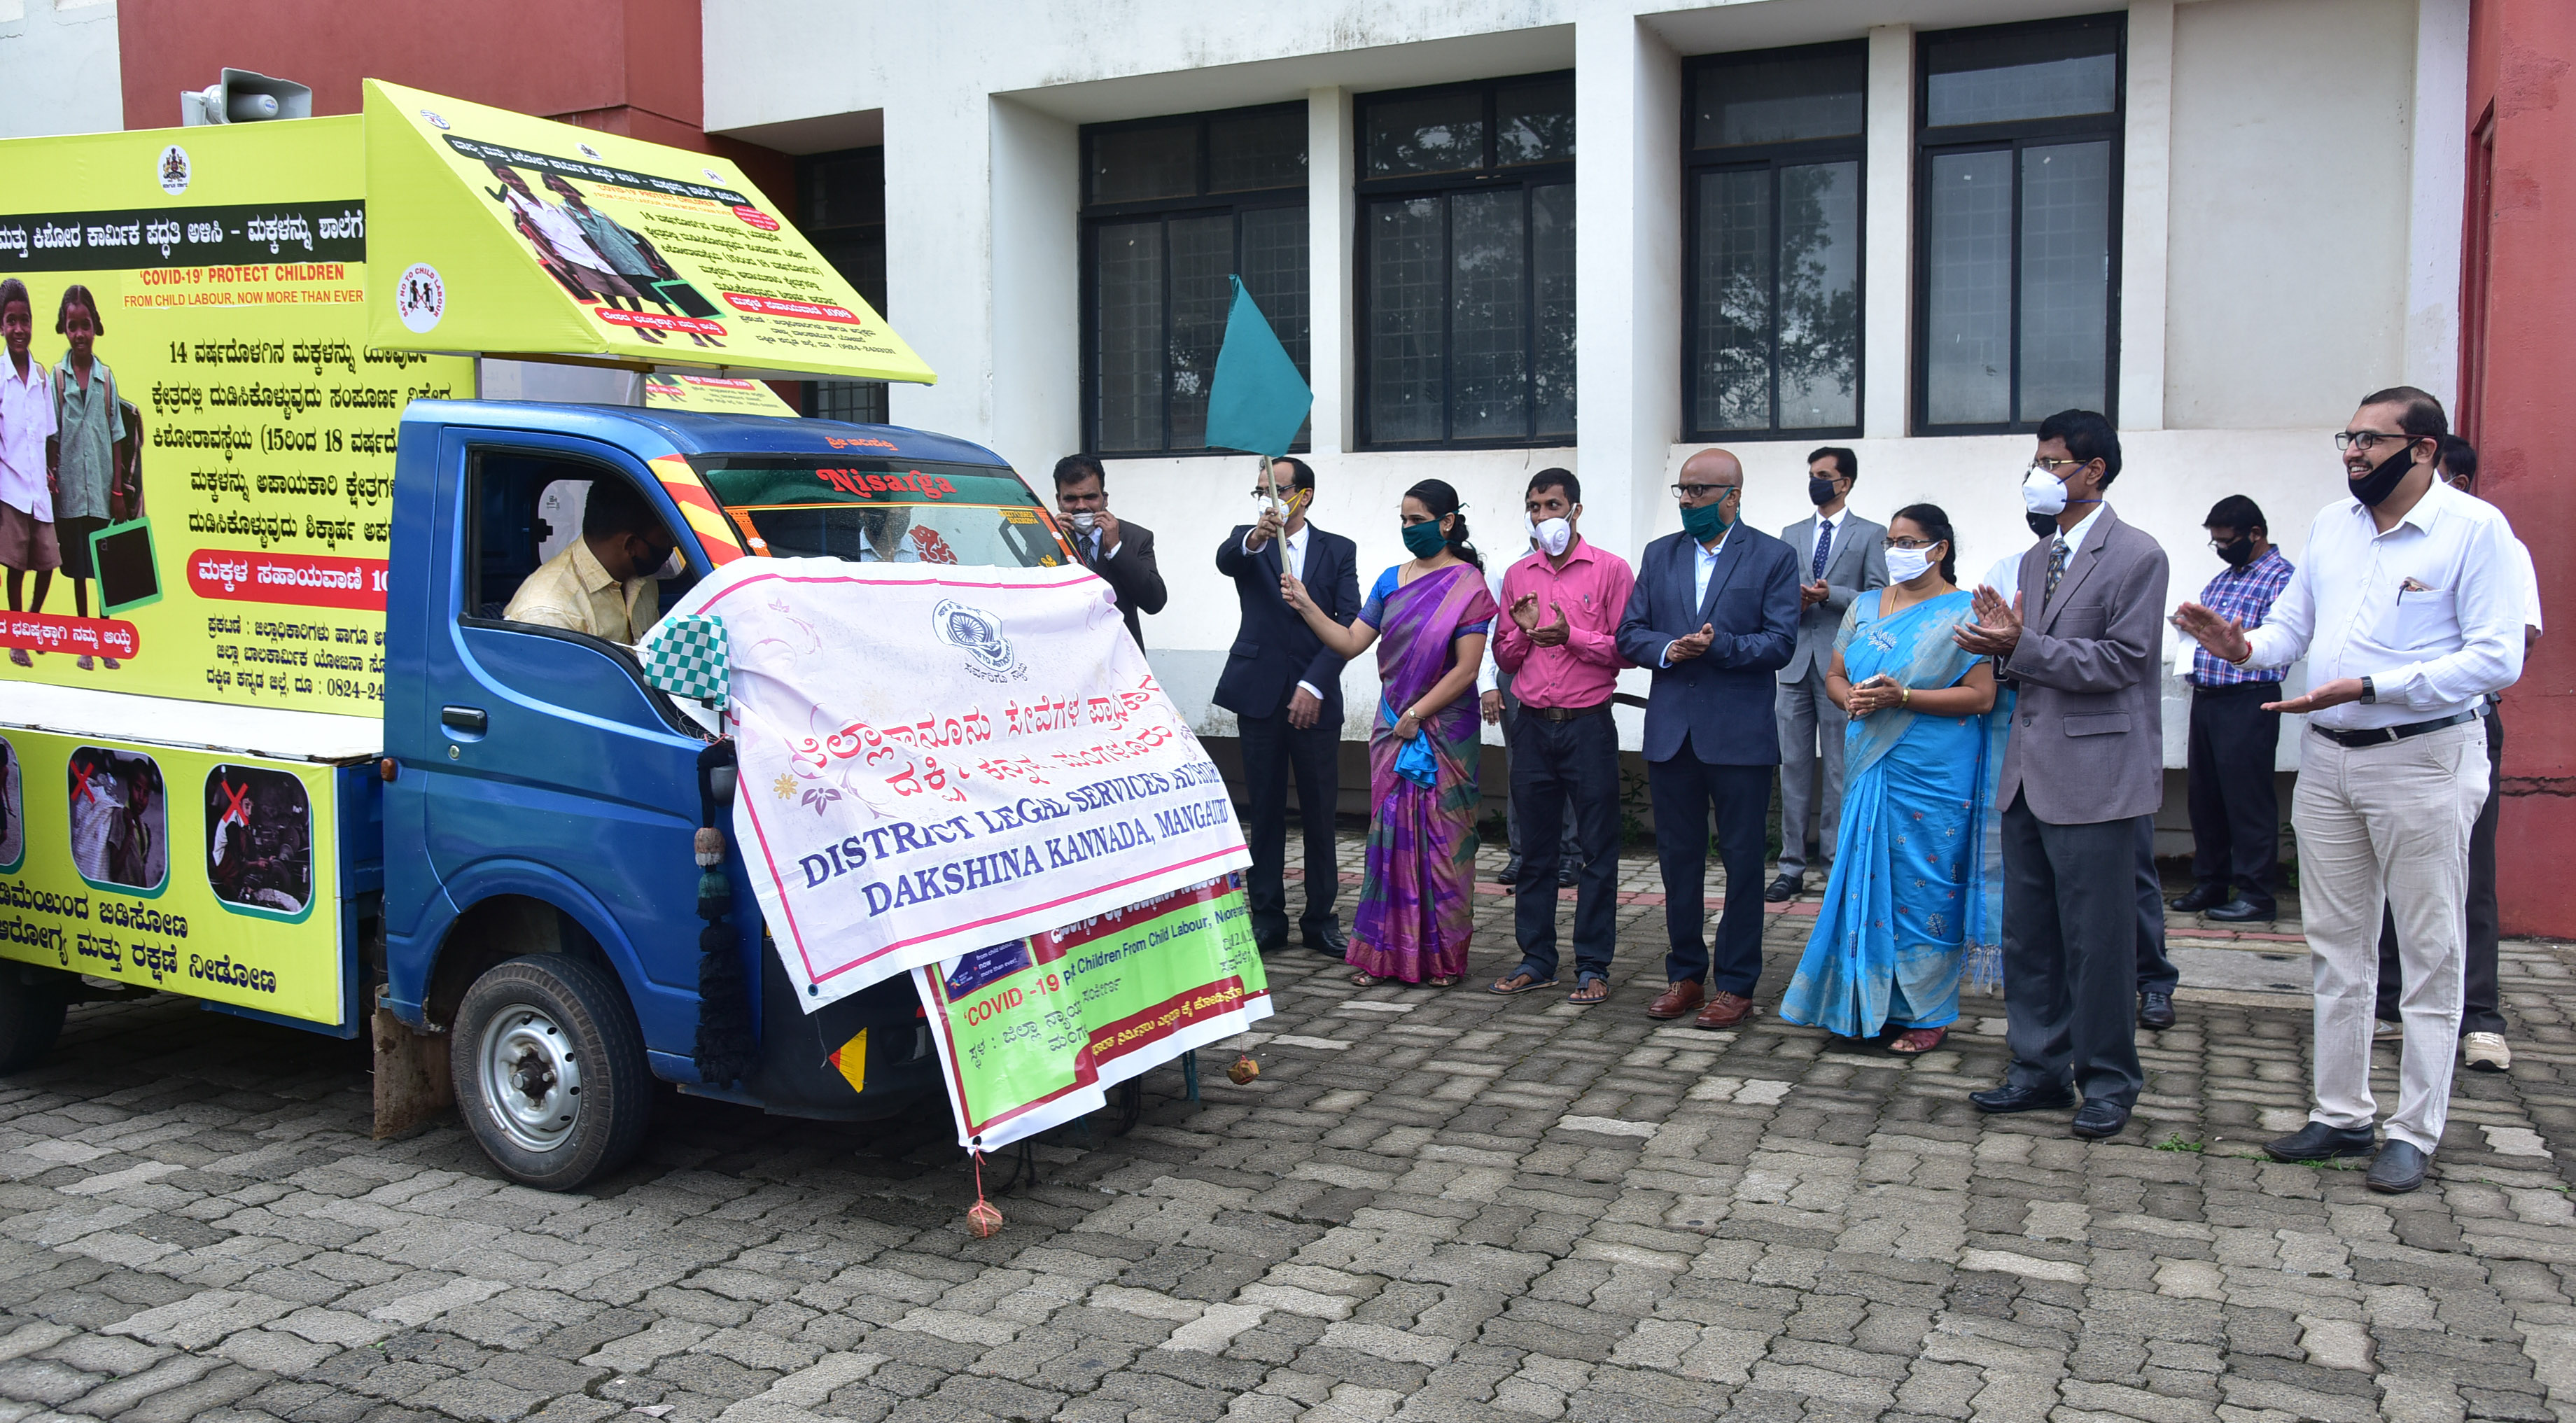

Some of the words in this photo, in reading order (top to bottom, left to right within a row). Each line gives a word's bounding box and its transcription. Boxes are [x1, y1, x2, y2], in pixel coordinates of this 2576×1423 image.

[639, 189, 676, 202] PROTECT
[676, 196, 717, 207] CHILDREN
[33, 221, 81, 248] ಕಿಶೋರ
[87, 219, 140, 246] ಕಾರ್ಮಿಕ
[188, 220, 223, 244] ಅಳಿಸಿ
[248, 213, 313, 254] ಮಕ್ಕಳನ್ನು
[318, 209, 363, 239] ಶಾಲೆಗೆ
[209, 266, 268, 283] PROTECT
[275, 265, 344, 281] CHILDREN
[400, 283, 406, 297] NO
[405, 272, 413, 281] TO
[415, 267, 435, 279] CHILD
[125, 295, 152, 307] FROM
[155, 294, 185, 306] CHILD
[188, 293, 234, 305] LABOUR,
[238, 292, 262, 304] NOW
[267, 291, 298, 303] MORE
[301, 290, 330, 302] THAN
[335, 290, 363, 302] EVER
[823, 308, 851, 318] 1098
[169, 341, 188, 363] 14
[195, 338, 284, 367] ವರ್ಷದೊಳಗಿನ
[293, 337, 356, 376] ಮಕ್ಕಳನ್ನು
[152, 381, 204, 416] ಕ್ಷೇತ್ರದಲ್ಲಿ
[330, 382, 398, 409] ಸಂಪೂರ್ಣ
[324, 429, 343, 452] 18
[190, 465, 250, 503] ಮಕ್ಕಳನ್ನು
[256, 469, 338, 496] ಅಪಾಯಕಾರಿ
[816, 468, 957, 498] Nisarga
[198, 557, 248, 592] ಮಕ್ಕಳ
[258, 561, 363, 590] ಸಹಾಯವಾಣಿ
[372, 570, 388, 591] 10
[73, 625, 99, 650] ನಮ್ಮ
[335, 624, 368, 645] ಹಾಗೂ
[216, 643, 239, 666] ಜಿಲ್ಲಾ
[237, 668, 264, 696] ಕನ್ನಡ
[327, 678, 384, 701] 0824-24
[1005, 692, 1079, 737] ಸೇವೆಗಳ
[799, 815, 976, 889] DISTRICT
[974, 798, 1070, 834] LEGAL
[1066, 772, 1170, 813] SERVICES
[862, 844, 1044, 918] DAKSHINA
[1044, 818, 1156, 869] KANNADA,
[0, 880, 89, 920] ಡಿಮೆಯಿಂದ
[99, 901, 188, 939] ಬಿಡಿಸೋಣ
[988, 947, 999, 956] child
[1077, 947, 1122, 974] Children
[1123, 938, 1147, 962] From
[1148, 927, 1170, 950] Child
[1172, 915, 1212, 939] Labour,
[77, 928, 122, 972] ಮತ್ತು
[131, 937, 178, 984] ರಕ್ಷಣೆ
[189, 952, 276, 994] ನೀಡೋಣ
[978, 960, 991, 969] now
[981, 969, 993, 978] more
[993, 964, 1004, 972] than
[1002, 1021, 1042, 1042] ಜಿಲ್ಲಾ
